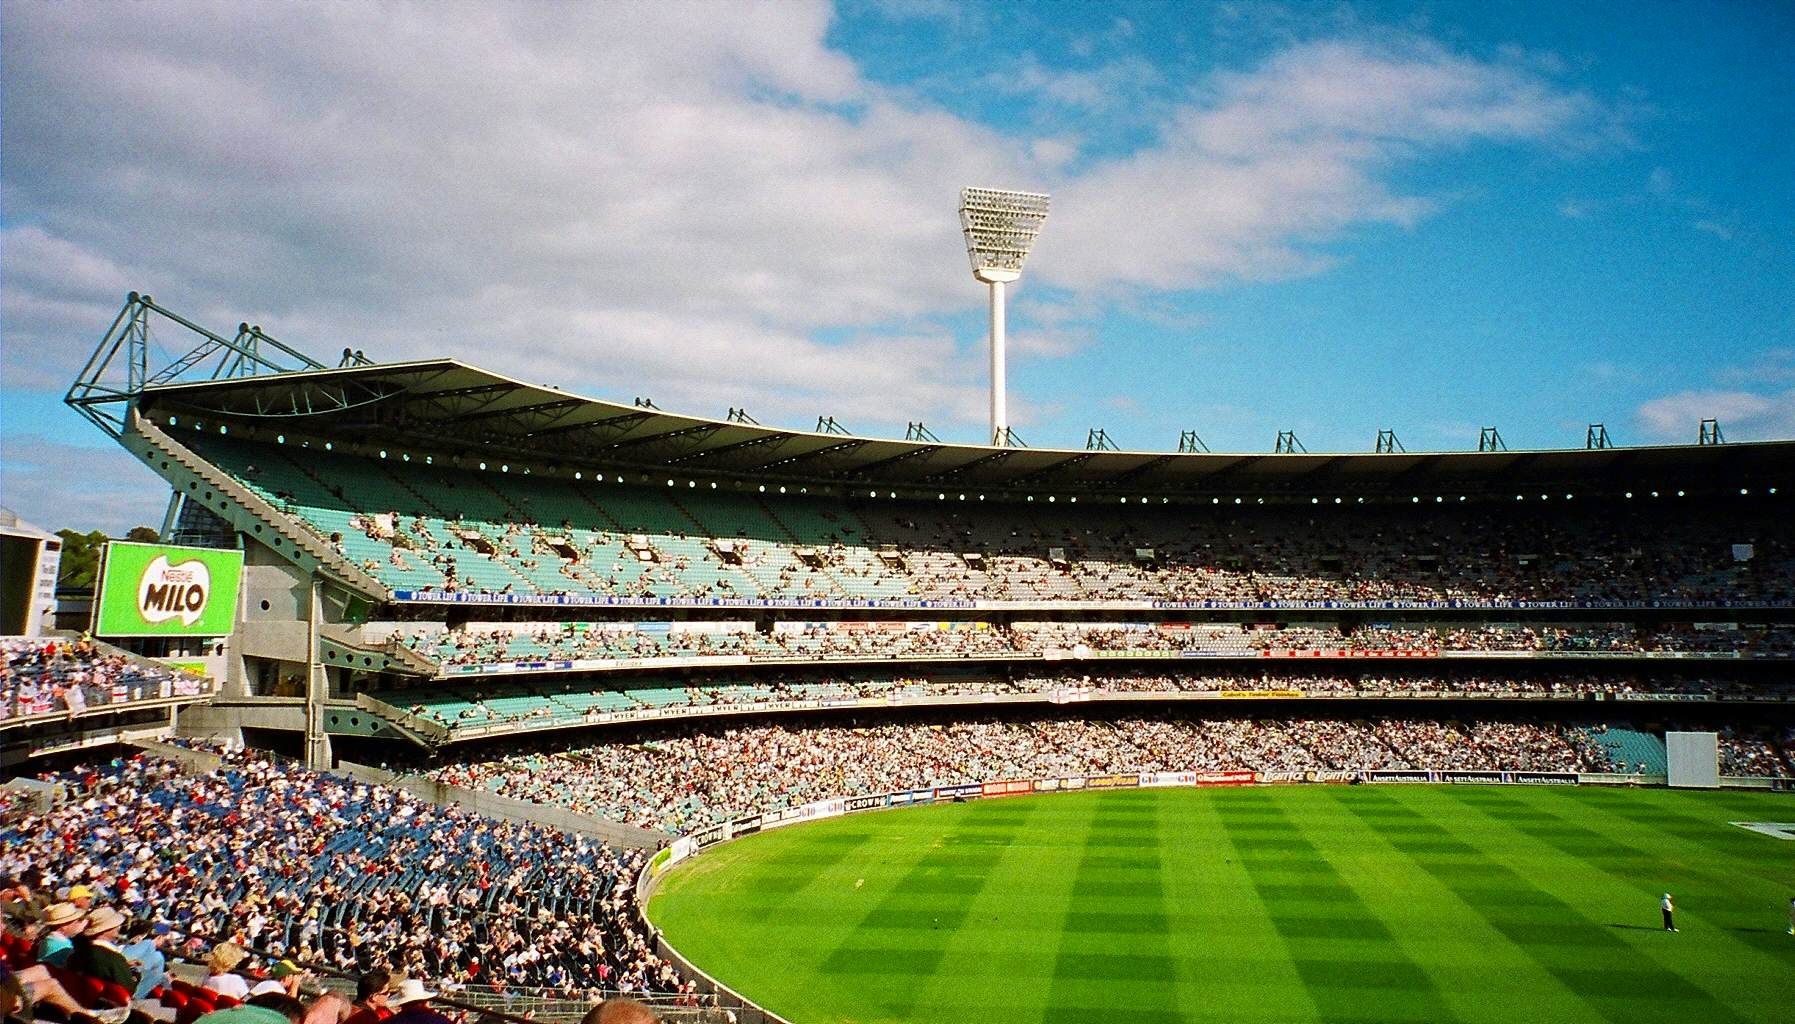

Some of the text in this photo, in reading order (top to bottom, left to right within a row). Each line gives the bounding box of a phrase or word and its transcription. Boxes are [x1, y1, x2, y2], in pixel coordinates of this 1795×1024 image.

[143, 583, 204, 612] MILO
[418, 593, 457, 601] TOWER LIFE
[468, 594, 508, 602] TOWER LIFE
[571, 596, 608, 604] TOWER LIFE
[852, 797, 880, 808] CROWN
